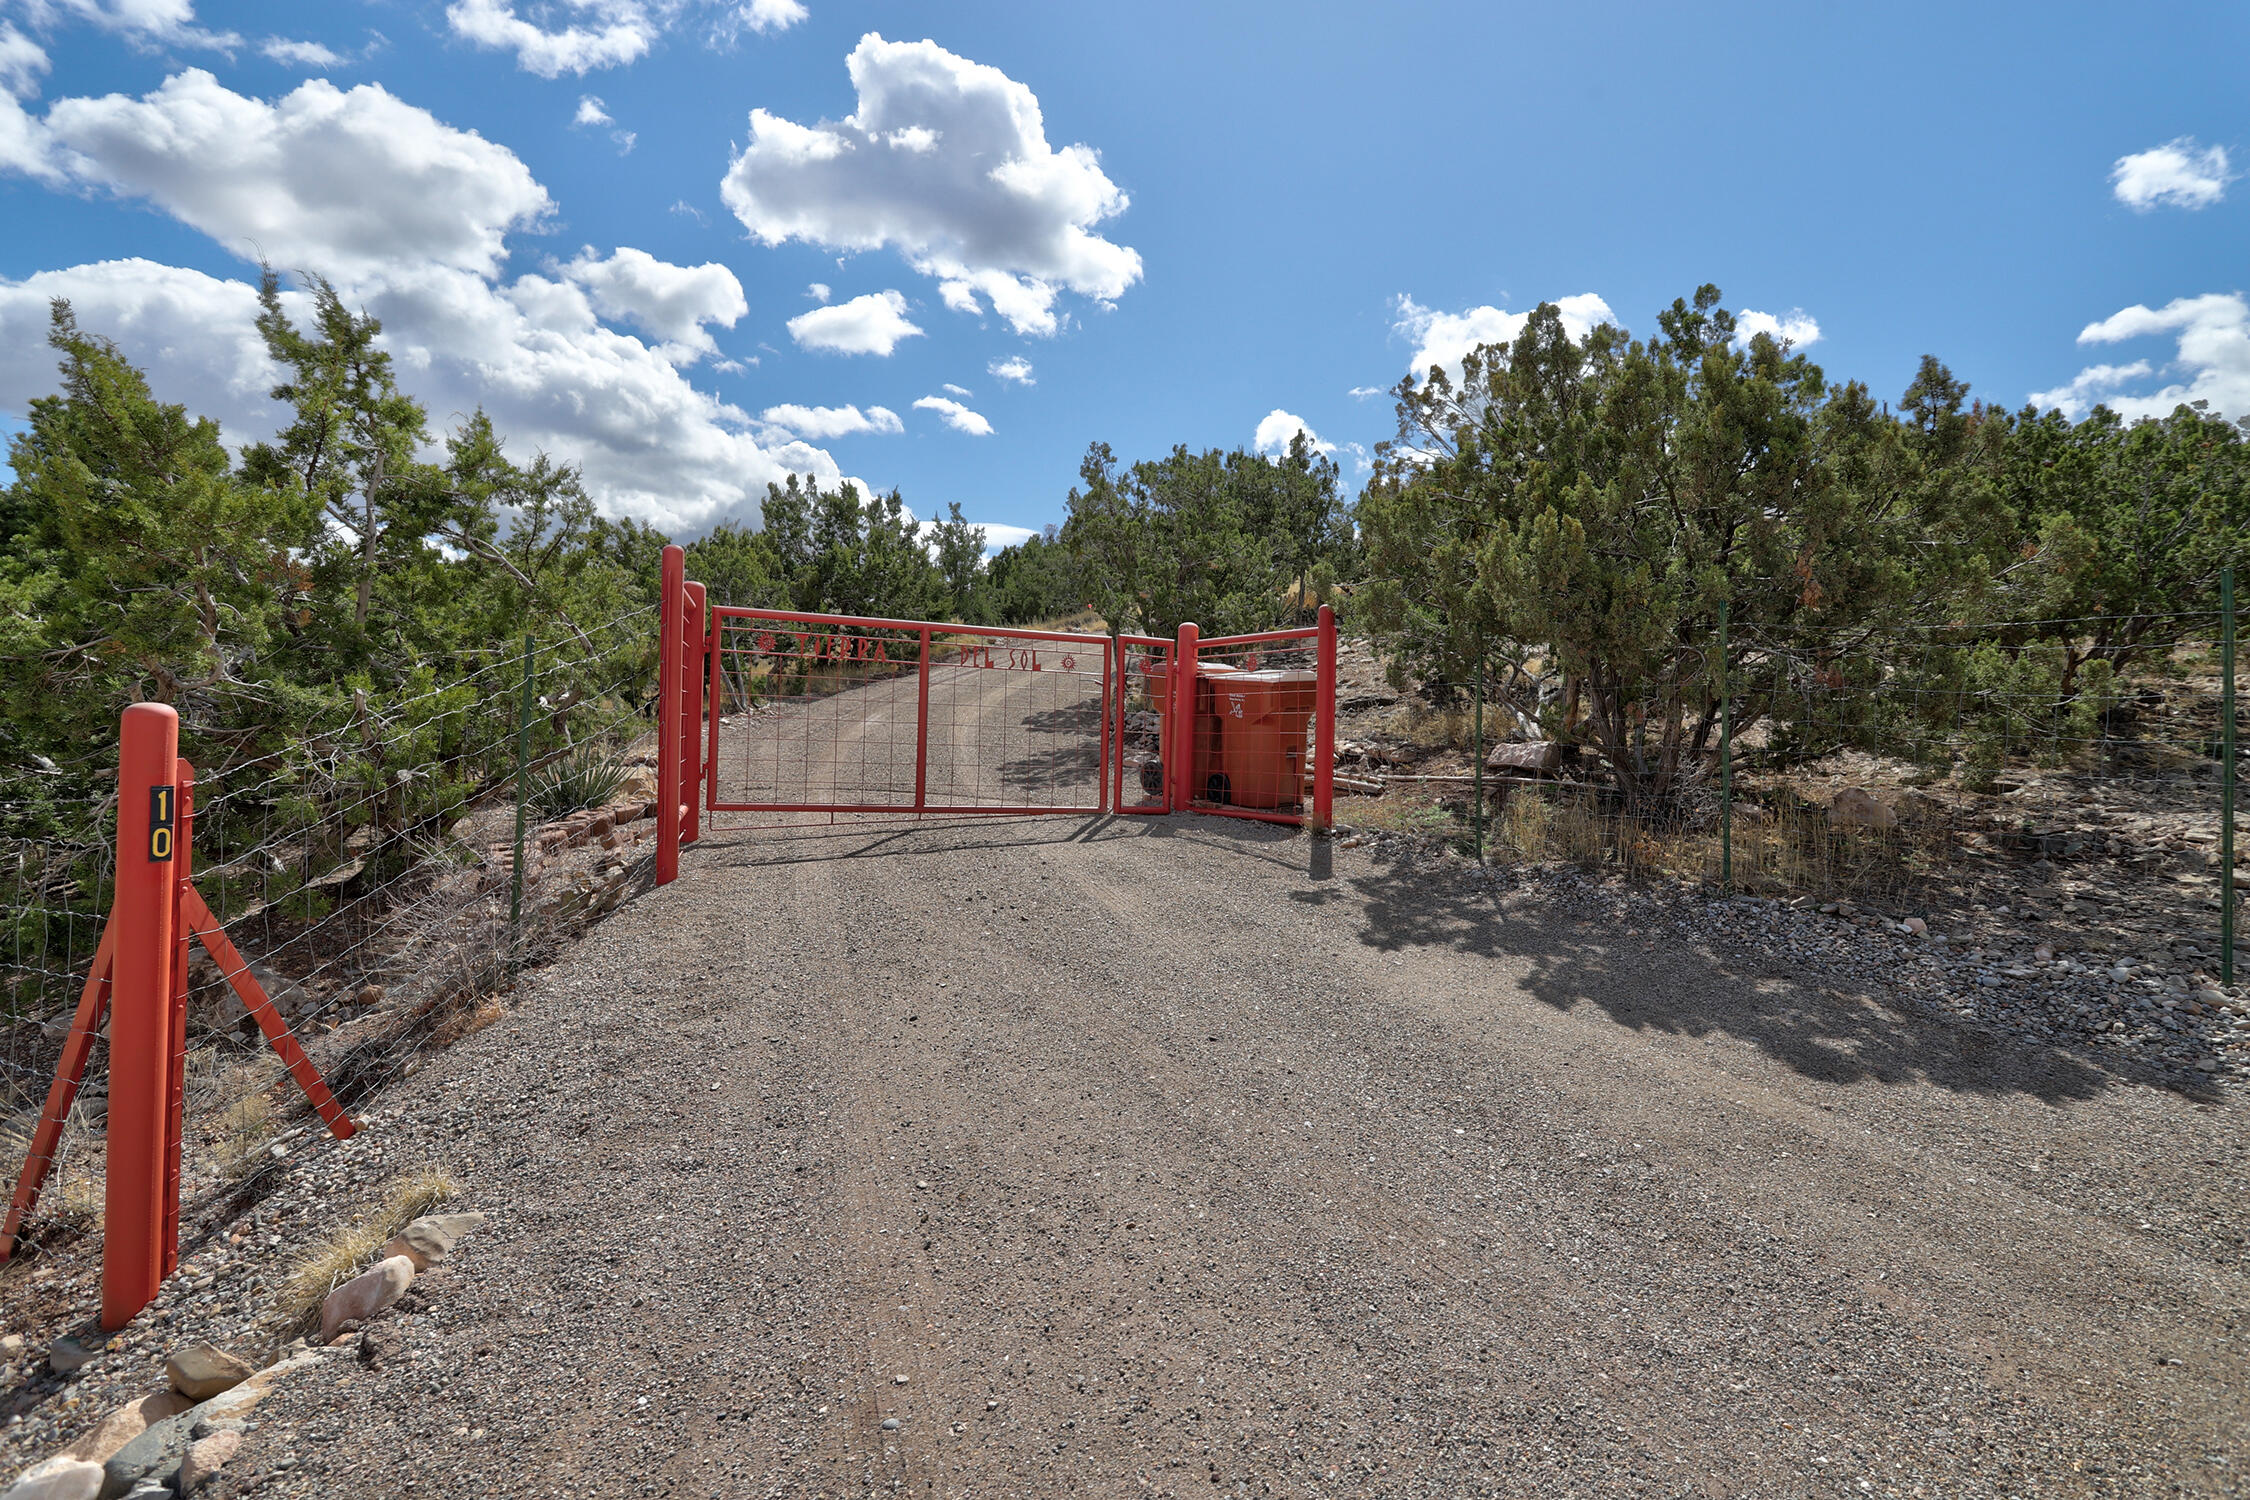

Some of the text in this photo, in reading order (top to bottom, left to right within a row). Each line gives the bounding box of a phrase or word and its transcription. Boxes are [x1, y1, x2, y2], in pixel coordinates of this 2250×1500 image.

[796, 634, 1041, 671] TIERRA DEL SOL
[152, 790, 171, 858] 10
